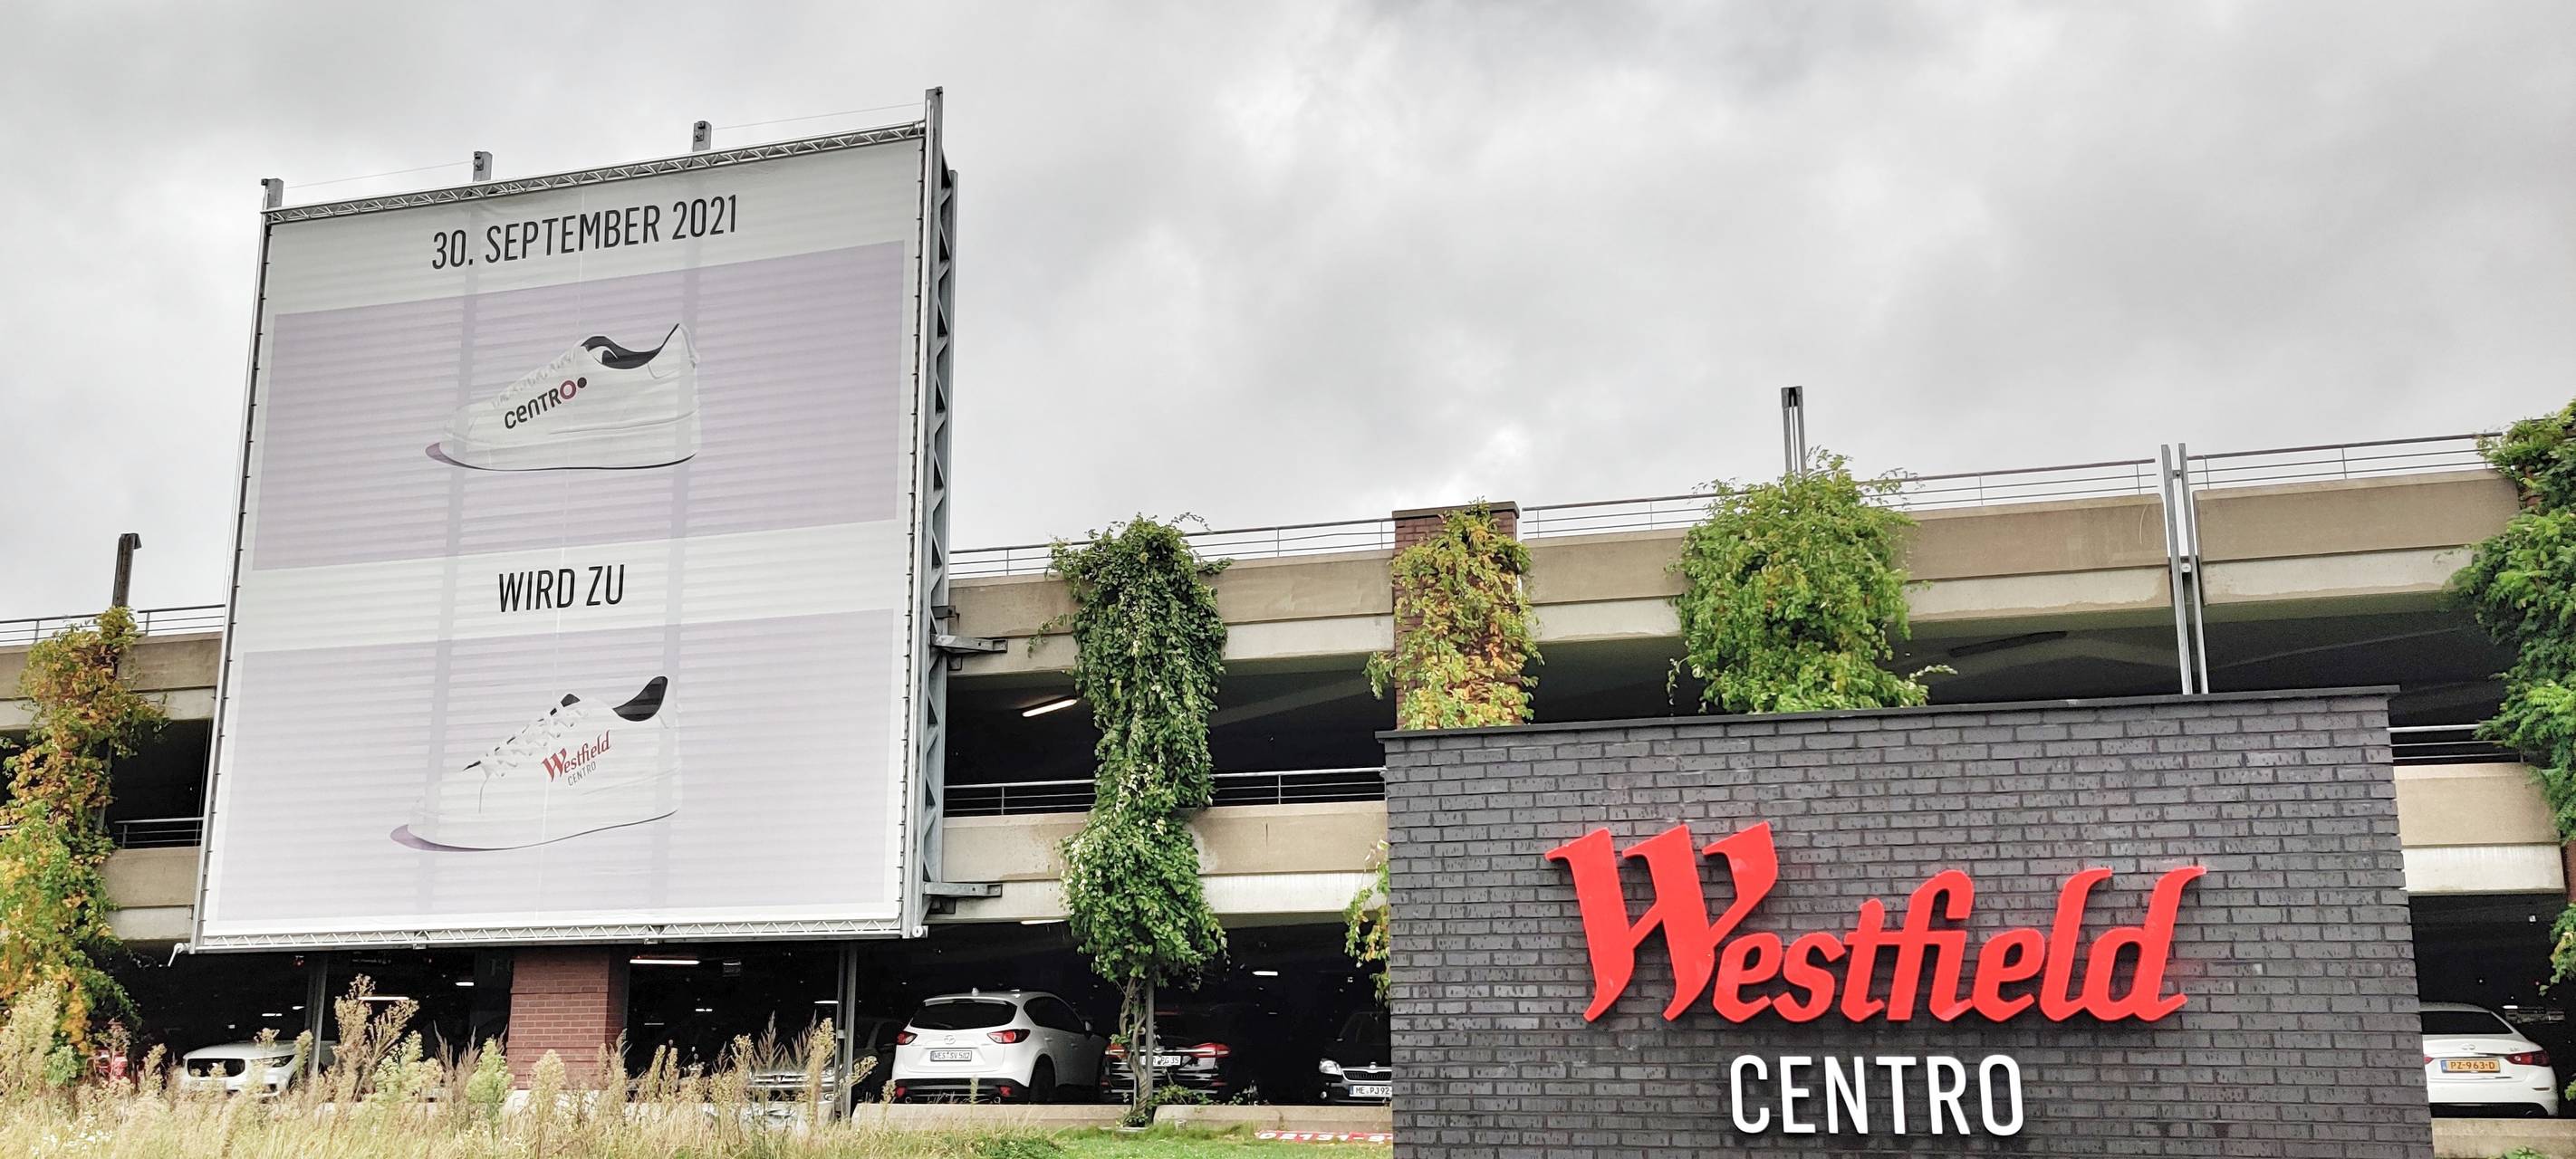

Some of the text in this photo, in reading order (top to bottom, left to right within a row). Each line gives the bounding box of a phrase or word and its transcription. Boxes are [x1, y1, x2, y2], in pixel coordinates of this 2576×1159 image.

[432, 194, 736, 270] 30. SEPTEMBER 2021
[498, 564, 625, 613] WIRD ZU
[541, 729, 610, 783] Westfield
[567, 761, 597, 787] CENTRO
[1544, 819, 2207, 1024] Westfield
[1728, 1053, 2025, 1136] CENTRO
